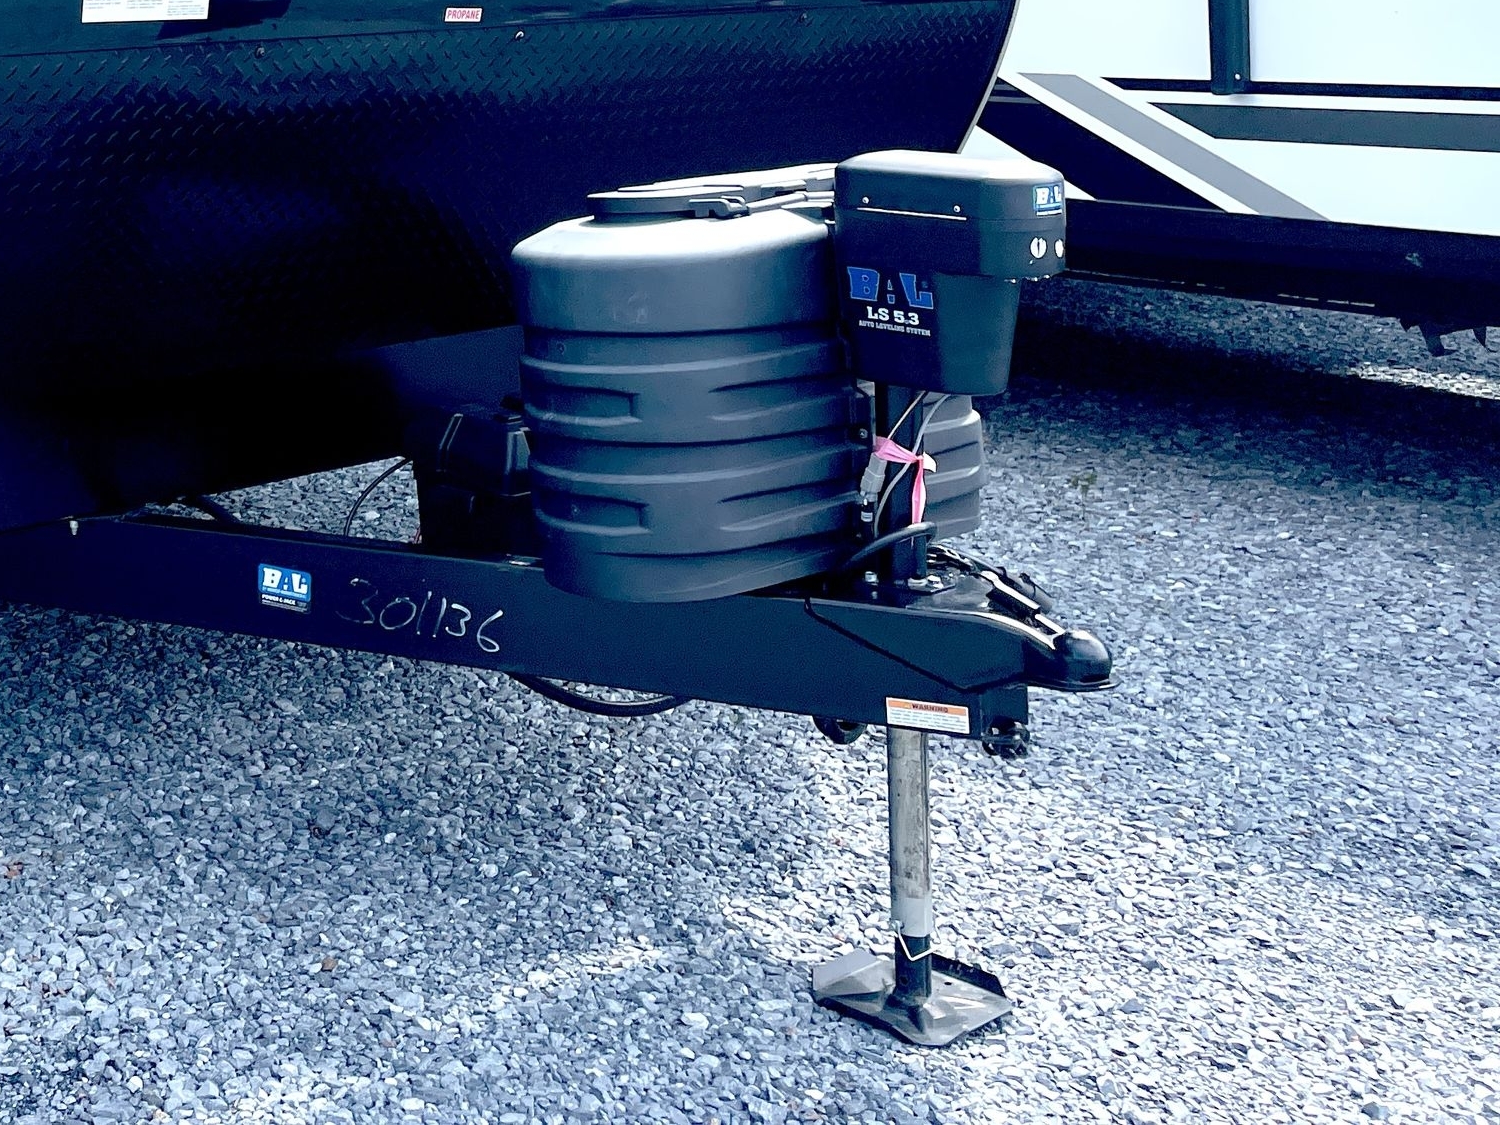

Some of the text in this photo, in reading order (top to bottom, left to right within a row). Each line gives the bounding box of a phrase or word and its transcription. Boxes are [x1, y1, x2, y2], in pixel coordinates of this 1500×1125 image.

[447, 10, 481, 20] PROPANE
[846, 266, 934, 309] BAL
[866, 306, 920, 326] LS 5.3
[858, 320, 931, 337] AUTO LEVELING SYSTEM
[262, 567, 308, 595] BAL
[334, 577, 504, 653] 301136
[911, 703, 949, 713] WARNING
